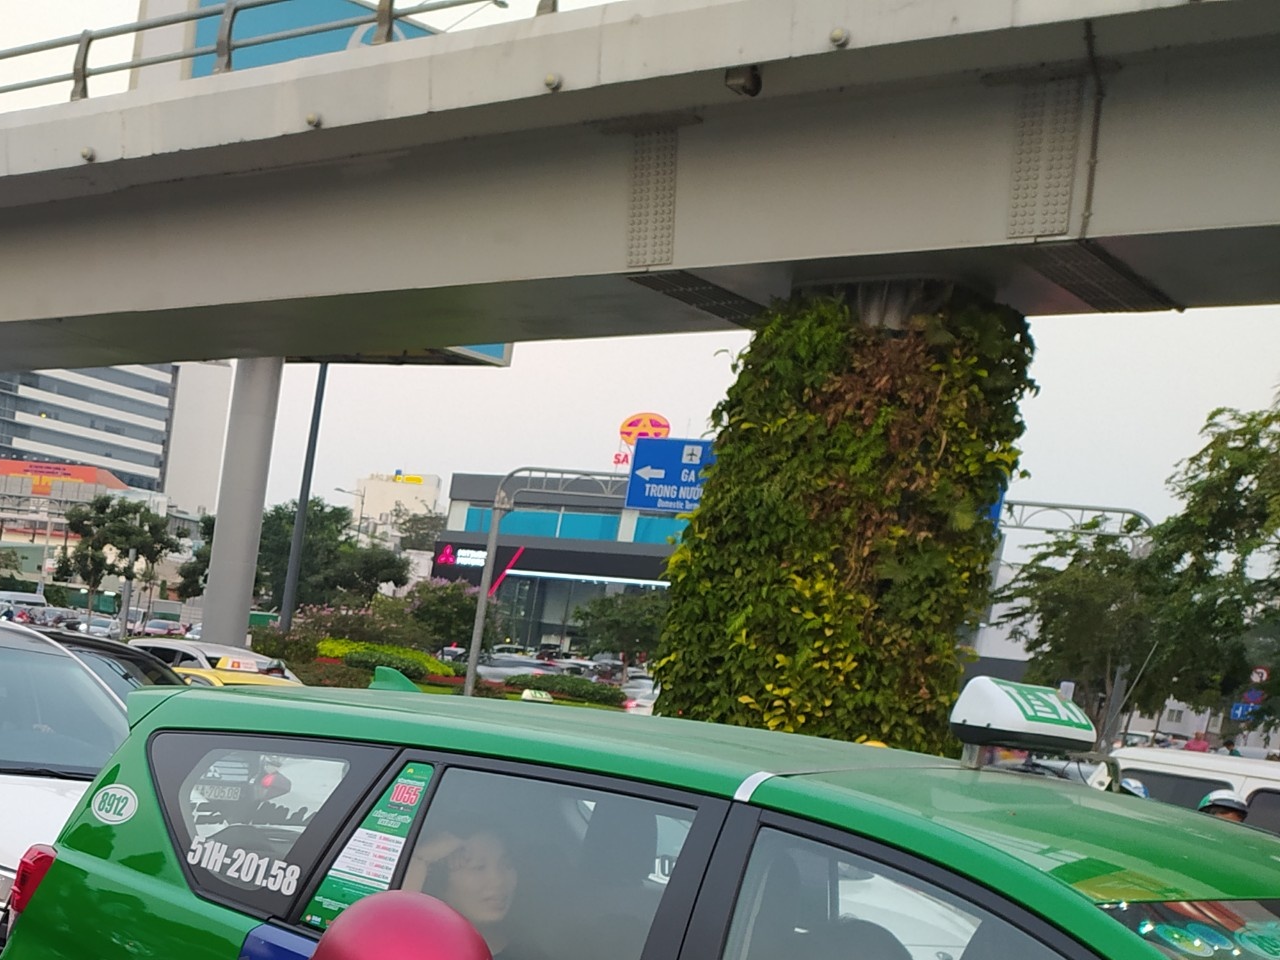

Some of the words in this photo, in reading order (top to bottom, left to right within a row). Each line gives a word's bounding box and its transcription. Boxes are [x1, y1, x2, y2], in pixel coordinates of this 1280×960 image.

[681, 469, 696, 483] GA
[645, 483, 677, 499] TRONG
[679, 483, 704, 500] NƯỚ
[97, 791, 128, 818] 8912
[390, 783, 424, 806] 1055
[187, 834, 301, 896] 51H-201.58
